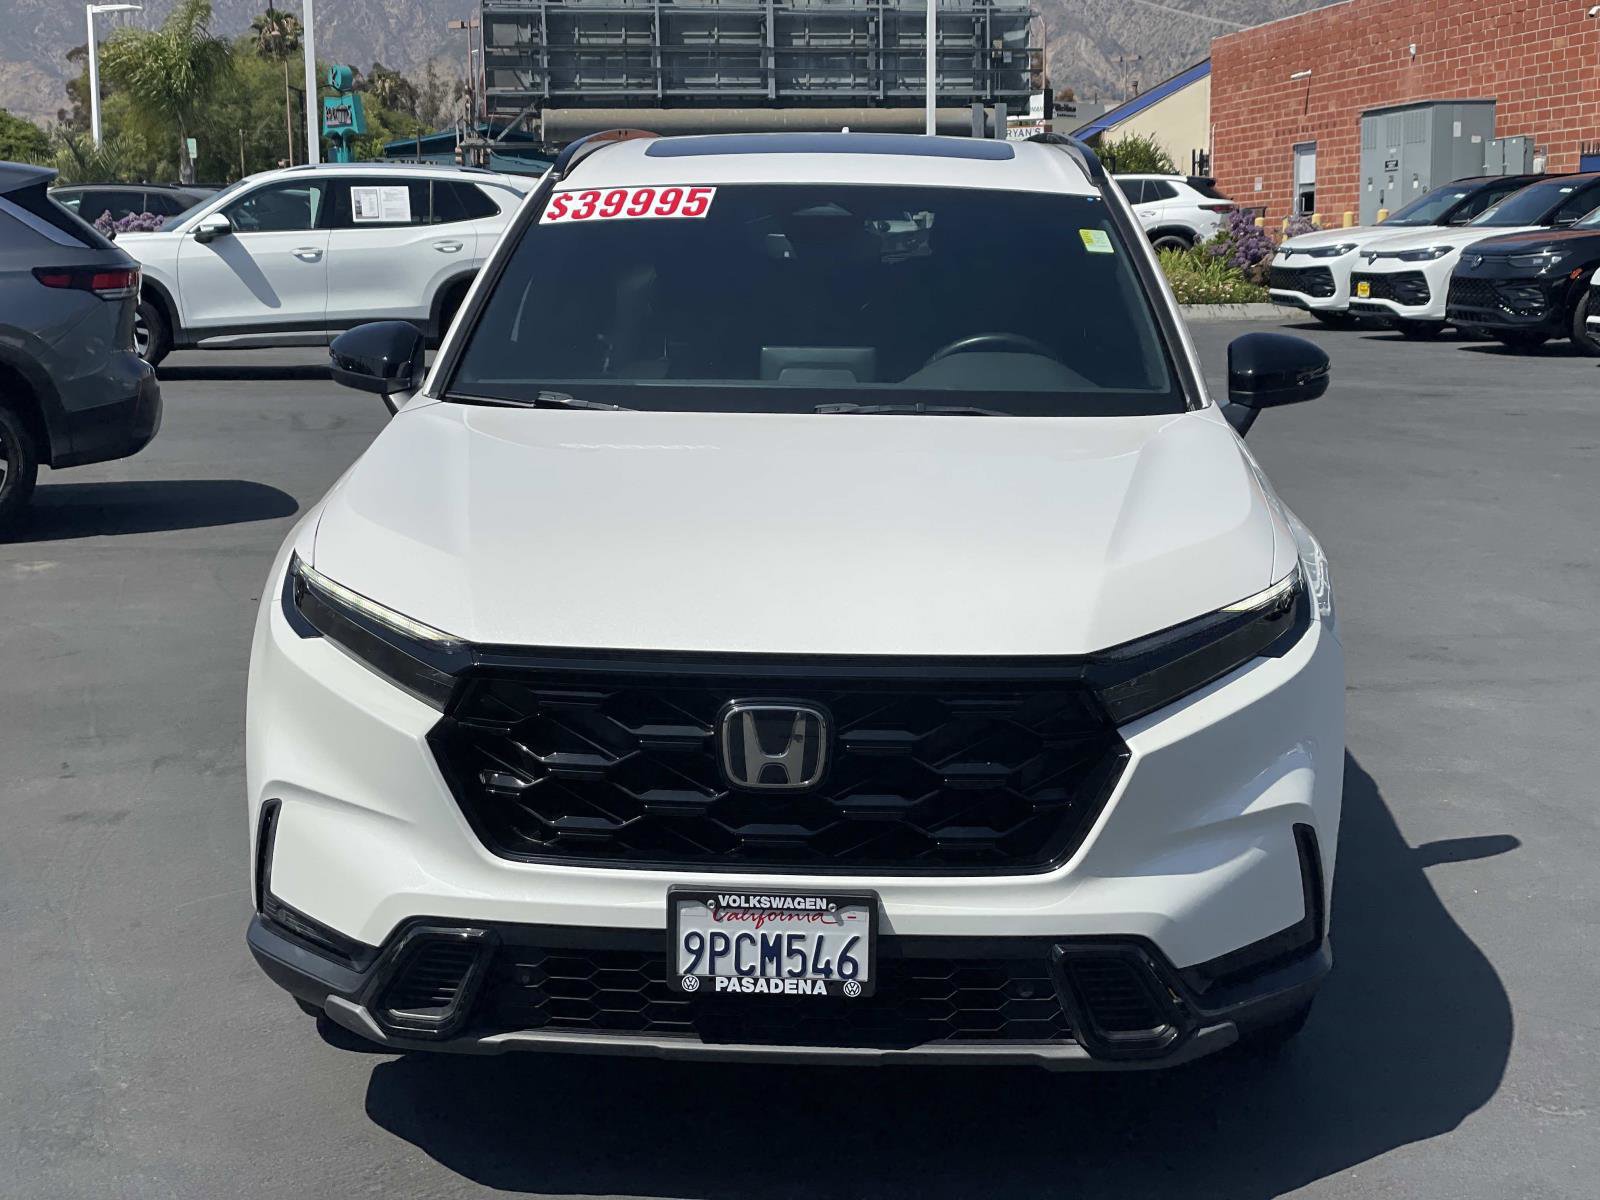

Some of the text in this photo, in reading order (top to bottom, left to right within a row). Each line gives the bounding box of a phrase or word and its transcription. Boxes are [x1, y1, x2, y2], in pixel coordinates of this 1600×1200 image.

[547, 188, 712, 221] $39995
[718, 895, 826, 910] VOLKSWAGEN
[712, 908, 839, 929] California
[683, 931, 861, 980] 9PCM546
[715, 977, 827, 995] PASADENA
